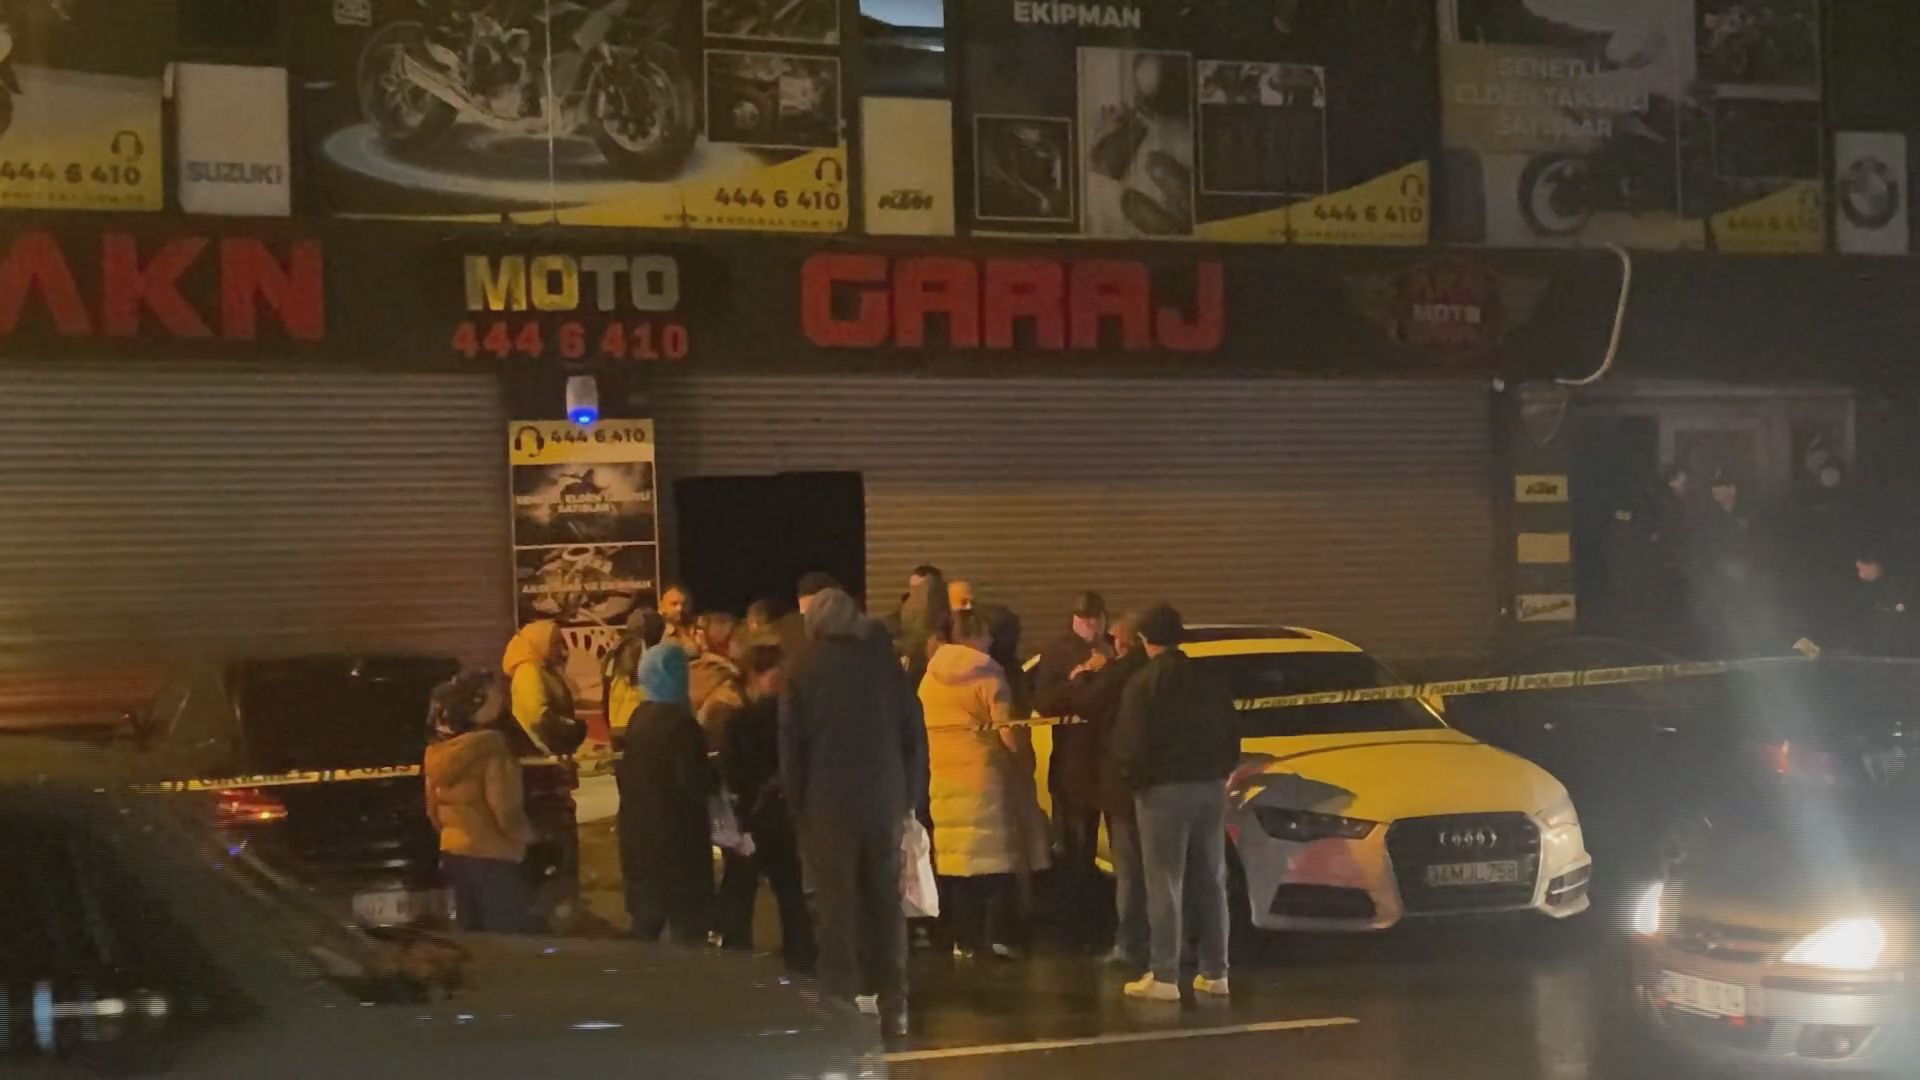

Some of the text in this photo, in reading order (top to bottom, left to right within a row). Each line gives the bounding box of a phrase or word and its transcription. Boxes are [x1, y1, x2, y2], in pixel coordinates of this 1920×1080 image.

[91, 162, 141, 186] 410
[186, 161, 283, 185] SUZUKI
[715, 188, 841, 211] 444 6 410
[1313, 203, 1357, 222] 444
[1384, 204, 1424, 224] 410
[463, 254, 681, 311] MOTO
[800, 252, 1225, 352] GARAJ
[452, 321, 689, 361] 444 6 410
[551, 427, 645, 443] 444 6 410
